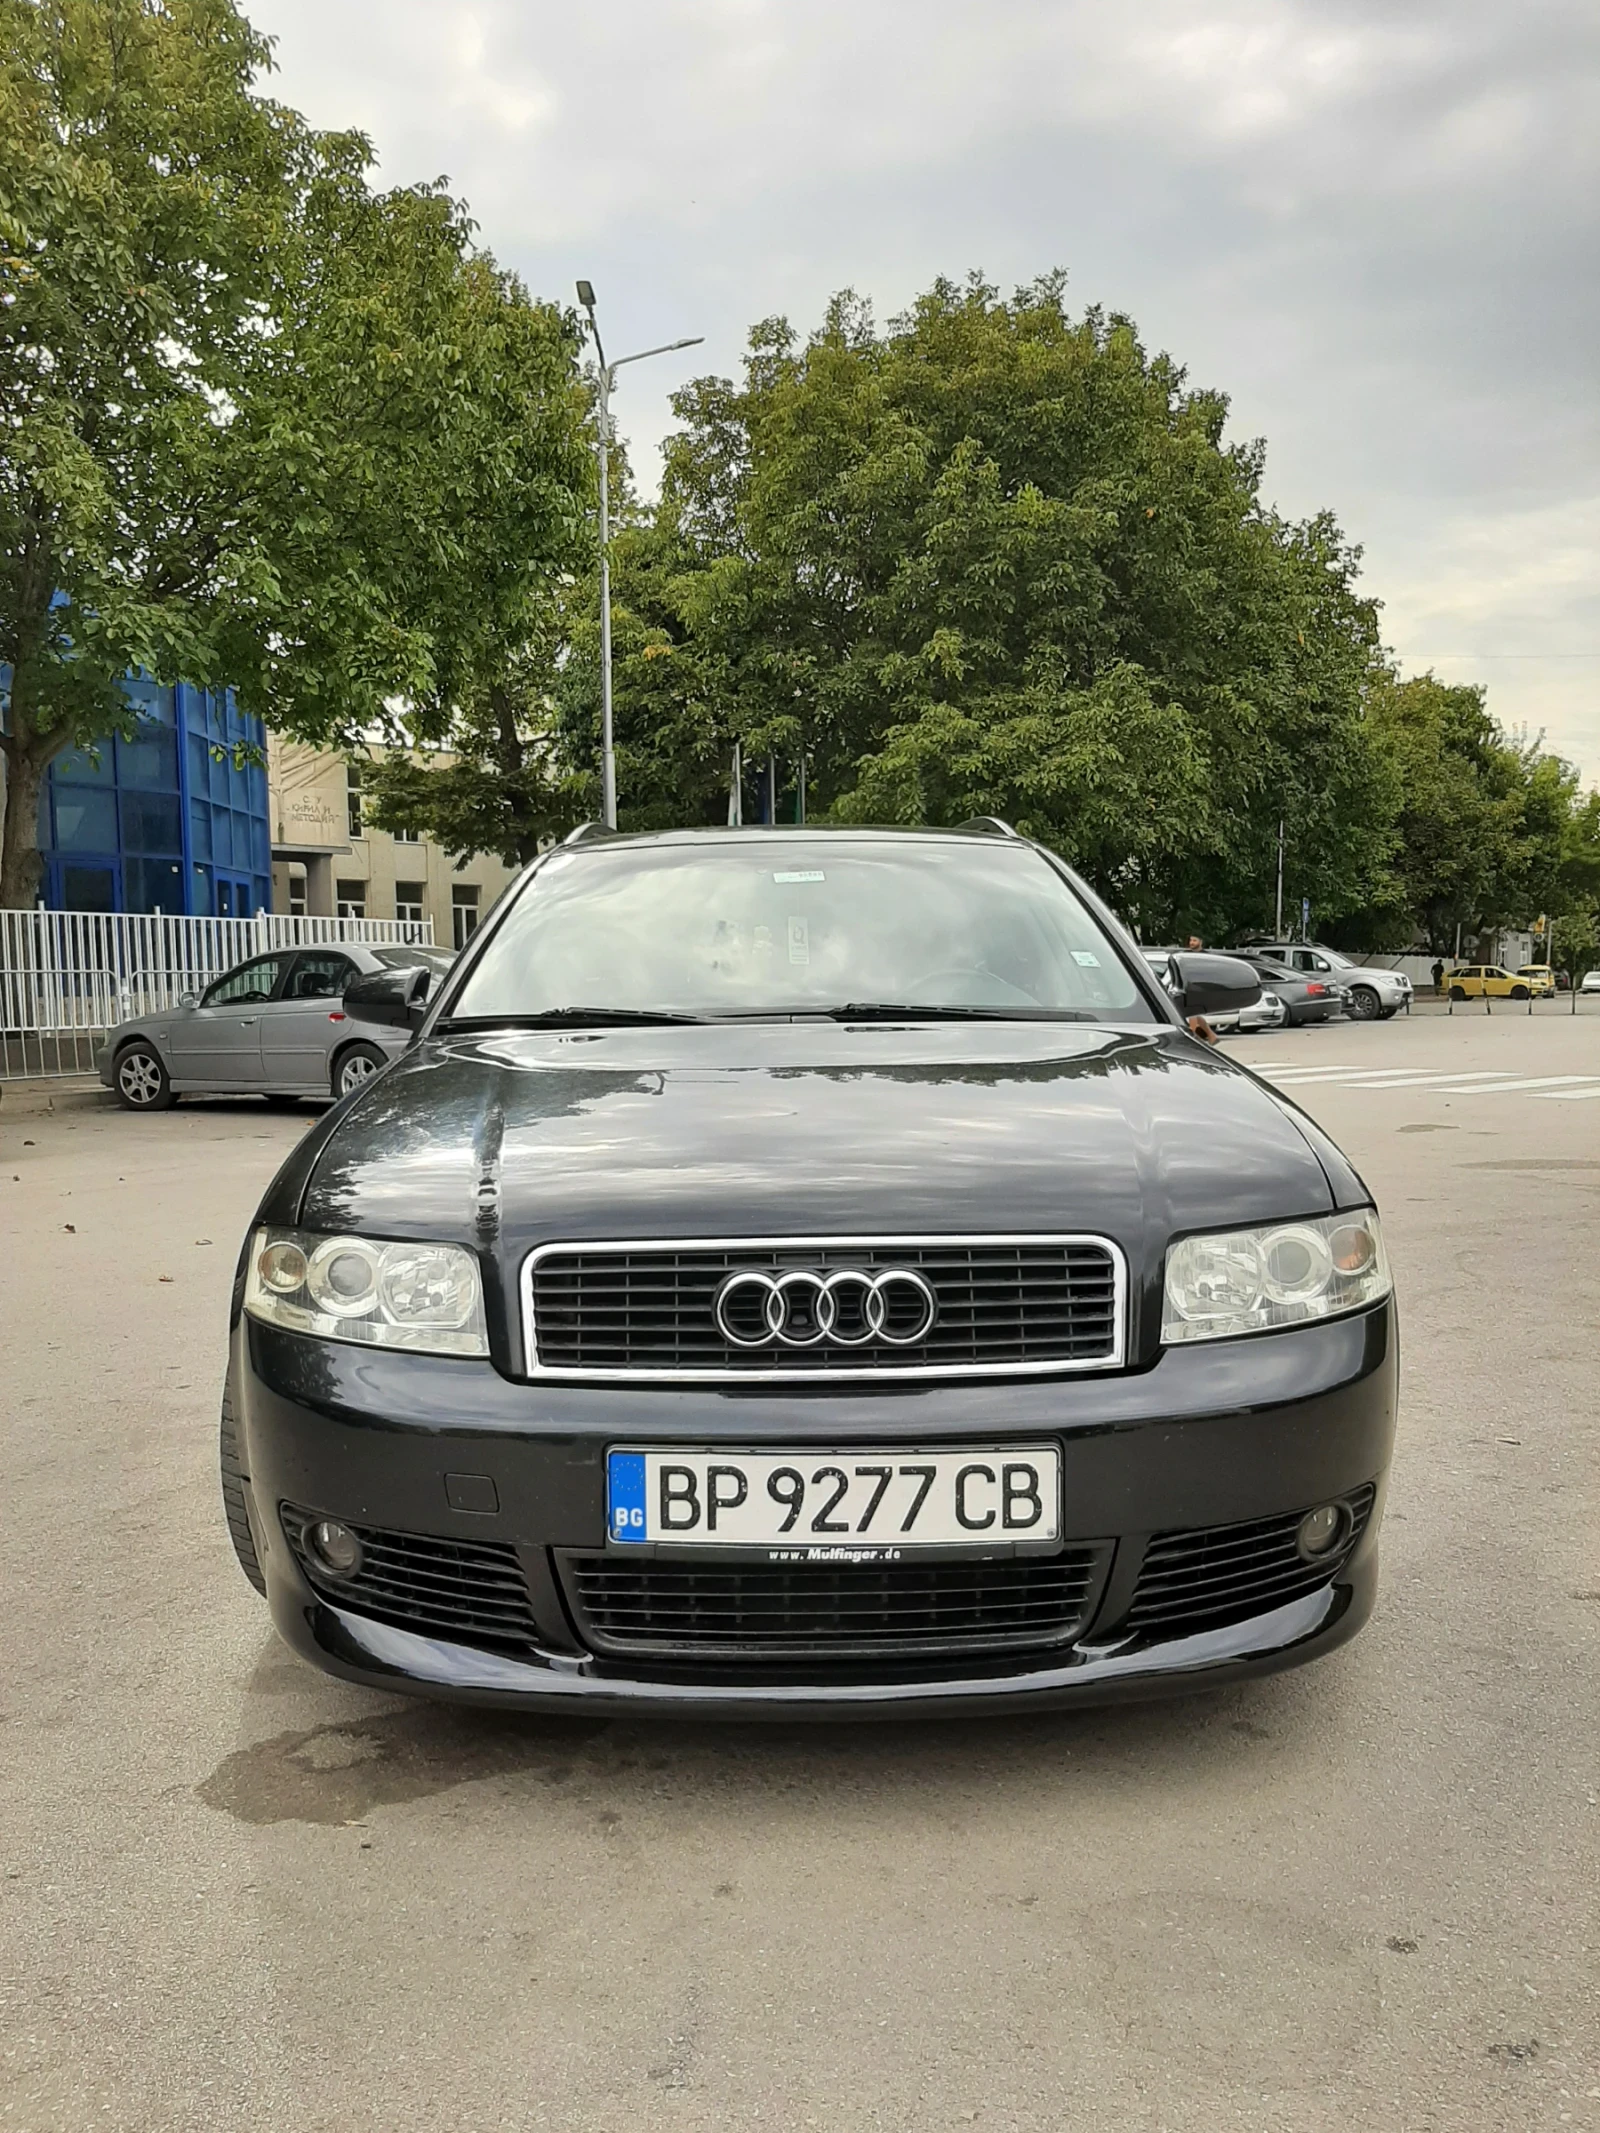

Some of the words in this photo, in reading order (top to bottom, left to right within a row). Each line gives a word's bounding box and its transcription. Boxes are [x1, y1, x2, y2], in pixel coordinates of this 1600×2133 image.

[615, 1507, 643, 1527] BG
[660, 1465, 748, 1531] BP
[767, 1465, 937, 1532] 9277
[955, 1463, 1042, 1530] CB
